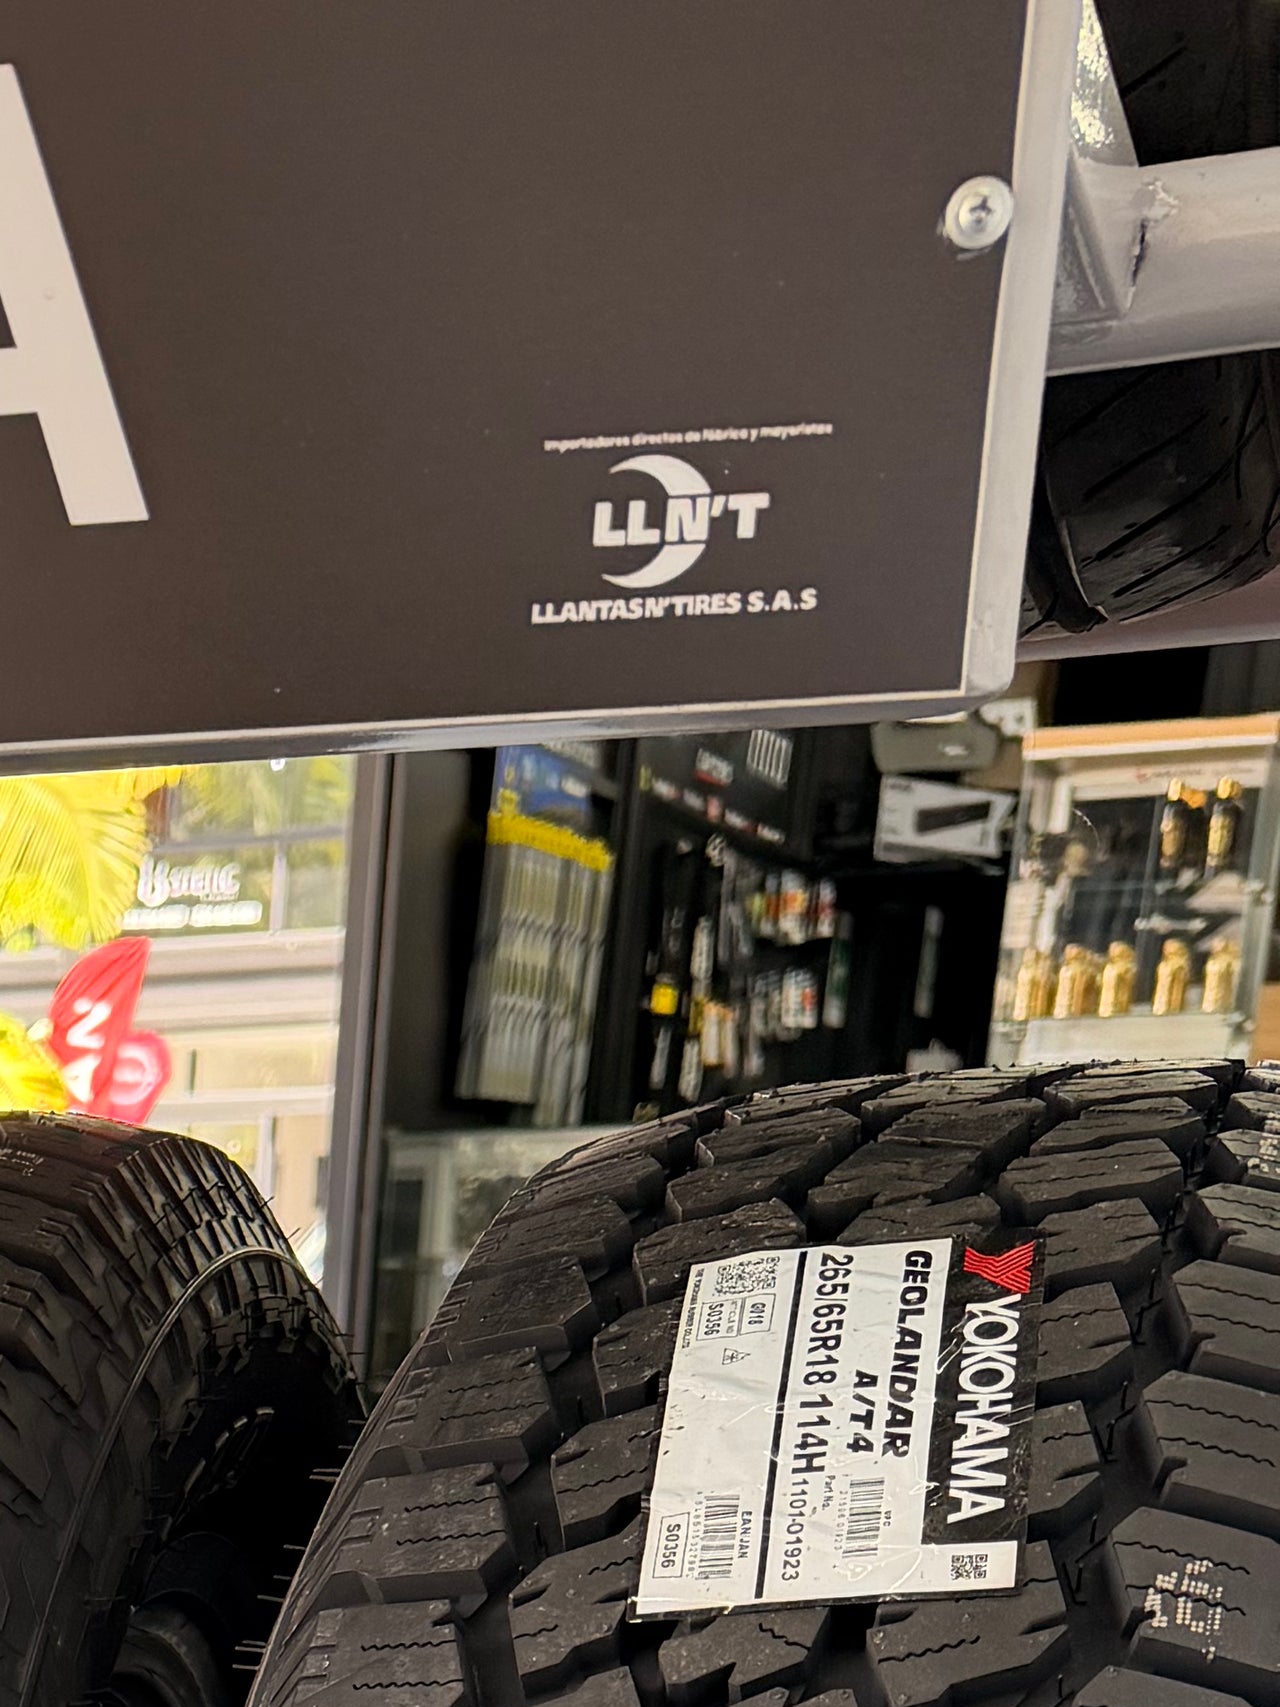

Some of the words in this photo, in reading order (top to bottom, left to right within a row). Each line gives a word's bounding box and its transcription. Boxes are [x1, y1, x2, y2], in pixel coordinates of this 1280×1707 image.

[747, 587, 818, 613] S.A.S
[704, 1303, 724, 1336] S0356
[803, 1252, 854, 1385] 265/65R18
[881, 1250, 934, 1458] GEOLANDAR
[791, 1394, 835, 1475] 114H
[846, 1369, 879, 1455] A/T4
[947, 1294, 1022, 1524] YOKOHAMA
[823, 1474, 836, 1496] Part
[660, 1523, 681, 1568] S0356
[781, 1477, 809, 1581] 1101-01923
